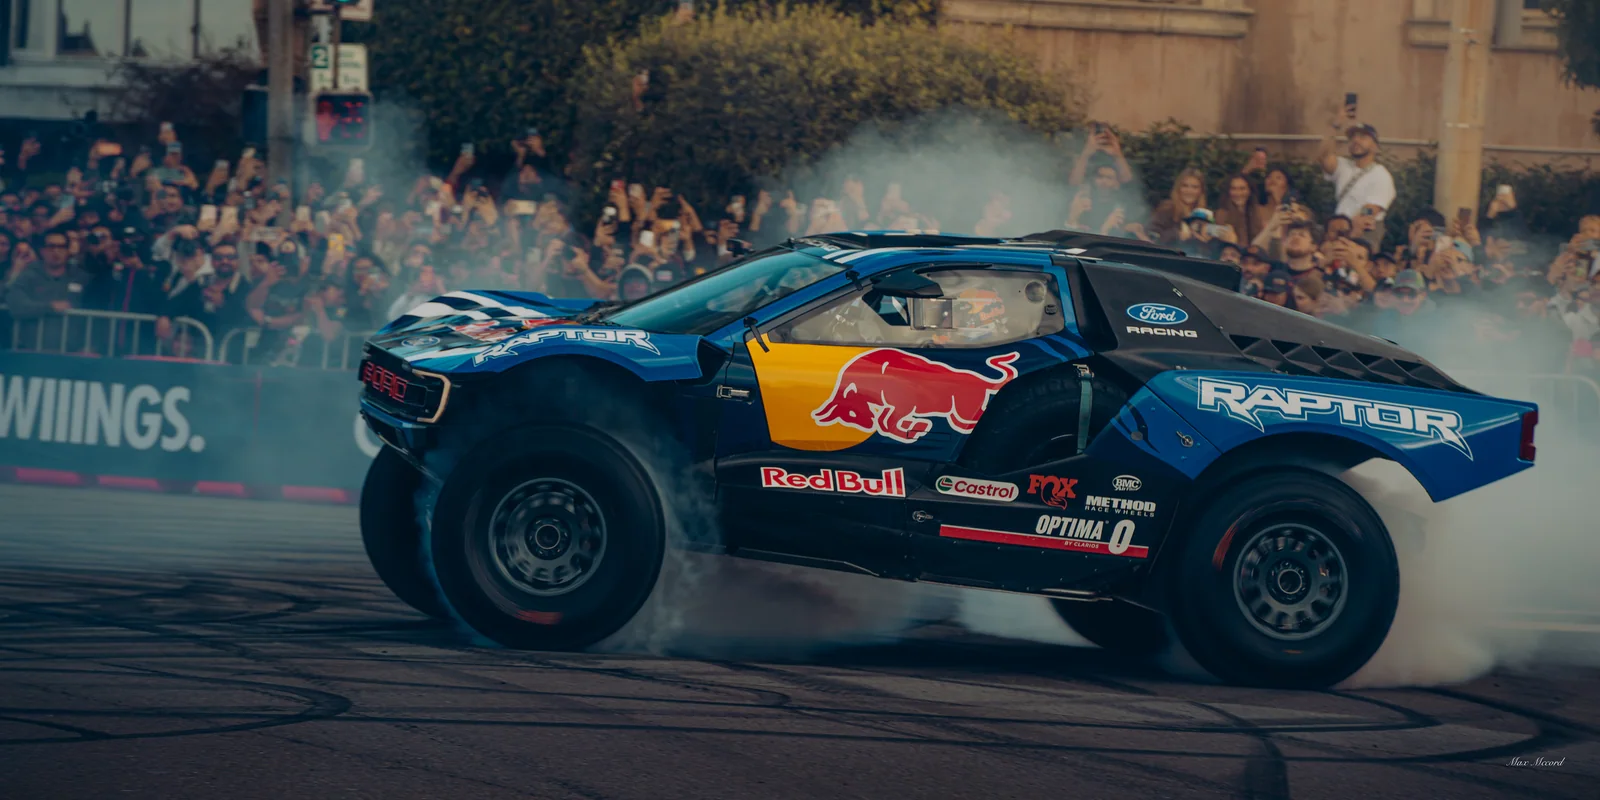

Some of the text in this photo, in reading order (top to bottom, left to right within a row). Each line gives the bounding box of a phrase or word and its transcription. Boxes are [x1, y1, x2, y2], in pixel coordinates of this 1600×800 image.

[1139, 305, 1177, 322] Ford
[1126, 326, 1198, 338] RACING
[473, 328, 661, 367] RAPTOR
[0, 373, 205, 453] WIIINGS.
[1198, 377, 1473, 461] RAPTOR
[760, 467, 906, 497] Red Bull
[955, 480, 1015, 499] Castrol
[1027, 474, 1078, 505] FOX
[1084, 505, 1155, 518] RACE WHEELS
[1085, 495, 1156, 512] METHOD
[1035, 514, 1104, 540] OPTIMA
